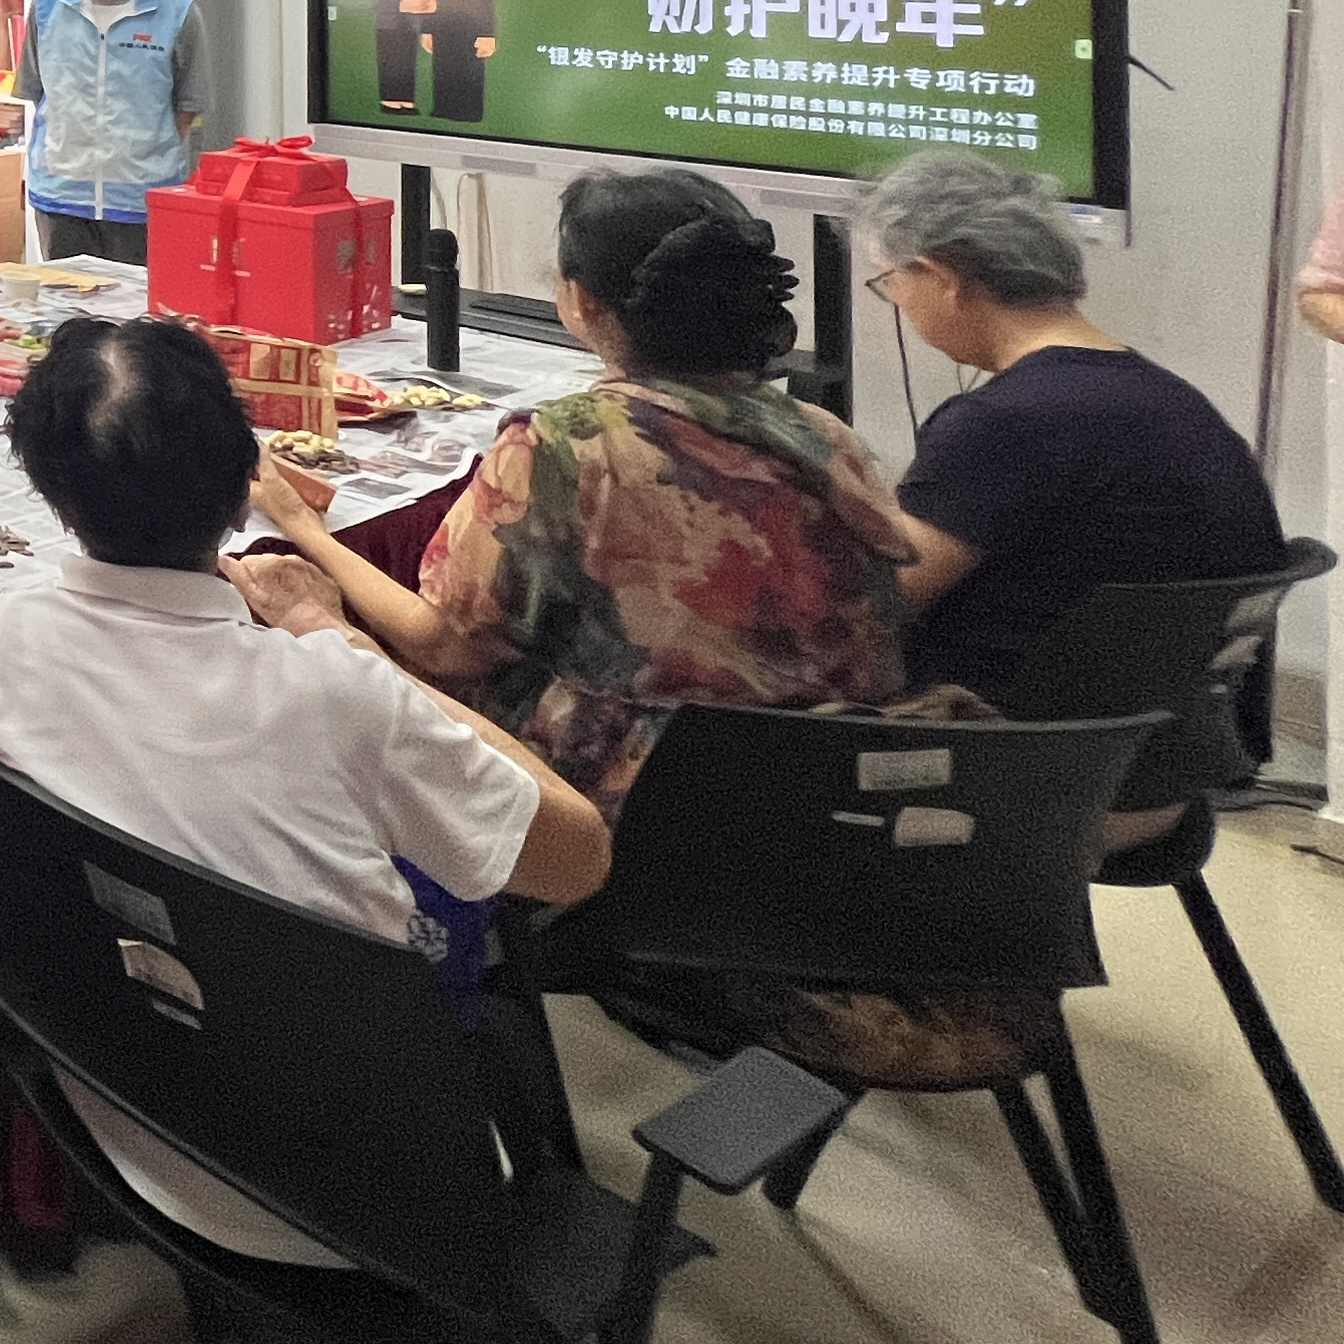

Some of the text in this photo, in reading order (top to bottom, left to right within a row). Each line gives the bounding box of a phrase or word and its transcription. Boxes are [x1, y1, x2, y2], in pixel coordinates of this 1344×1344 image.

[725, 57, 1037, 97] 金融素养提升专项行动
